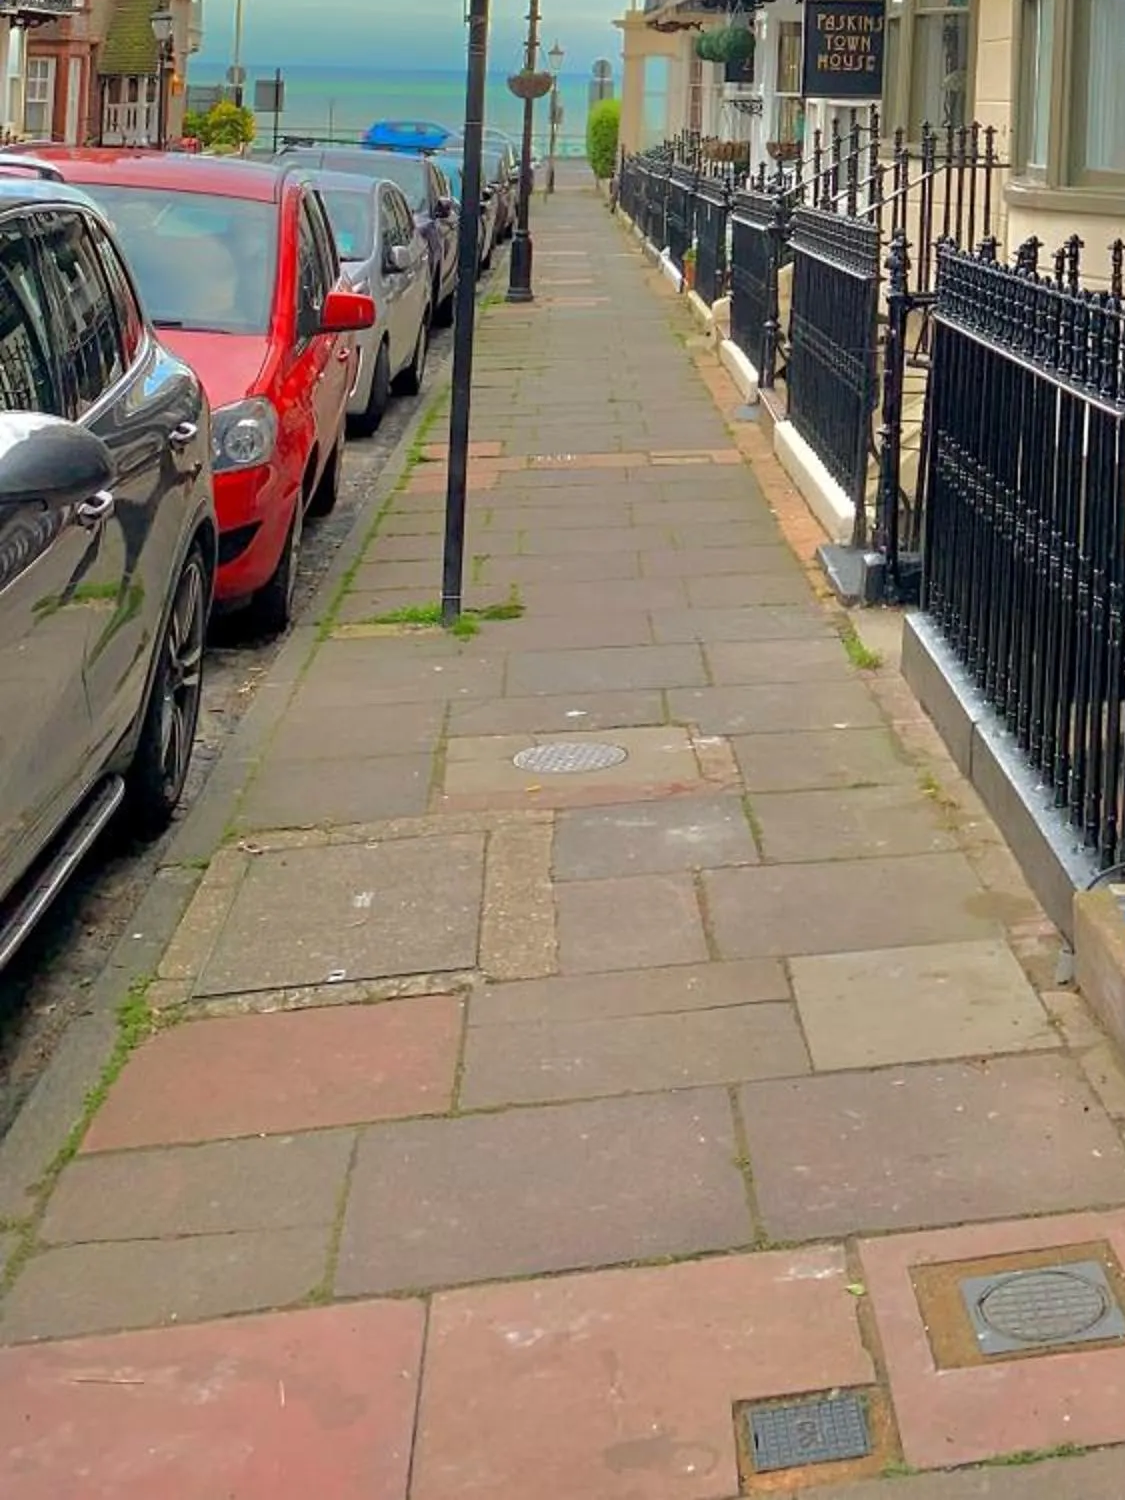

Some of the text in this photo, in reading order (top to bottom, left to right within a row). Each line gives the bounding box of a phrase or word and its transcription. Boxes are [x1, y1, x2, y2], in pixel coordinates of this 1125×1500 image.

[817, 13, 883, 33] PASKINS
[825, 33, 871, 53] TOWN
[817, 53, 877, 72] HOUSE
